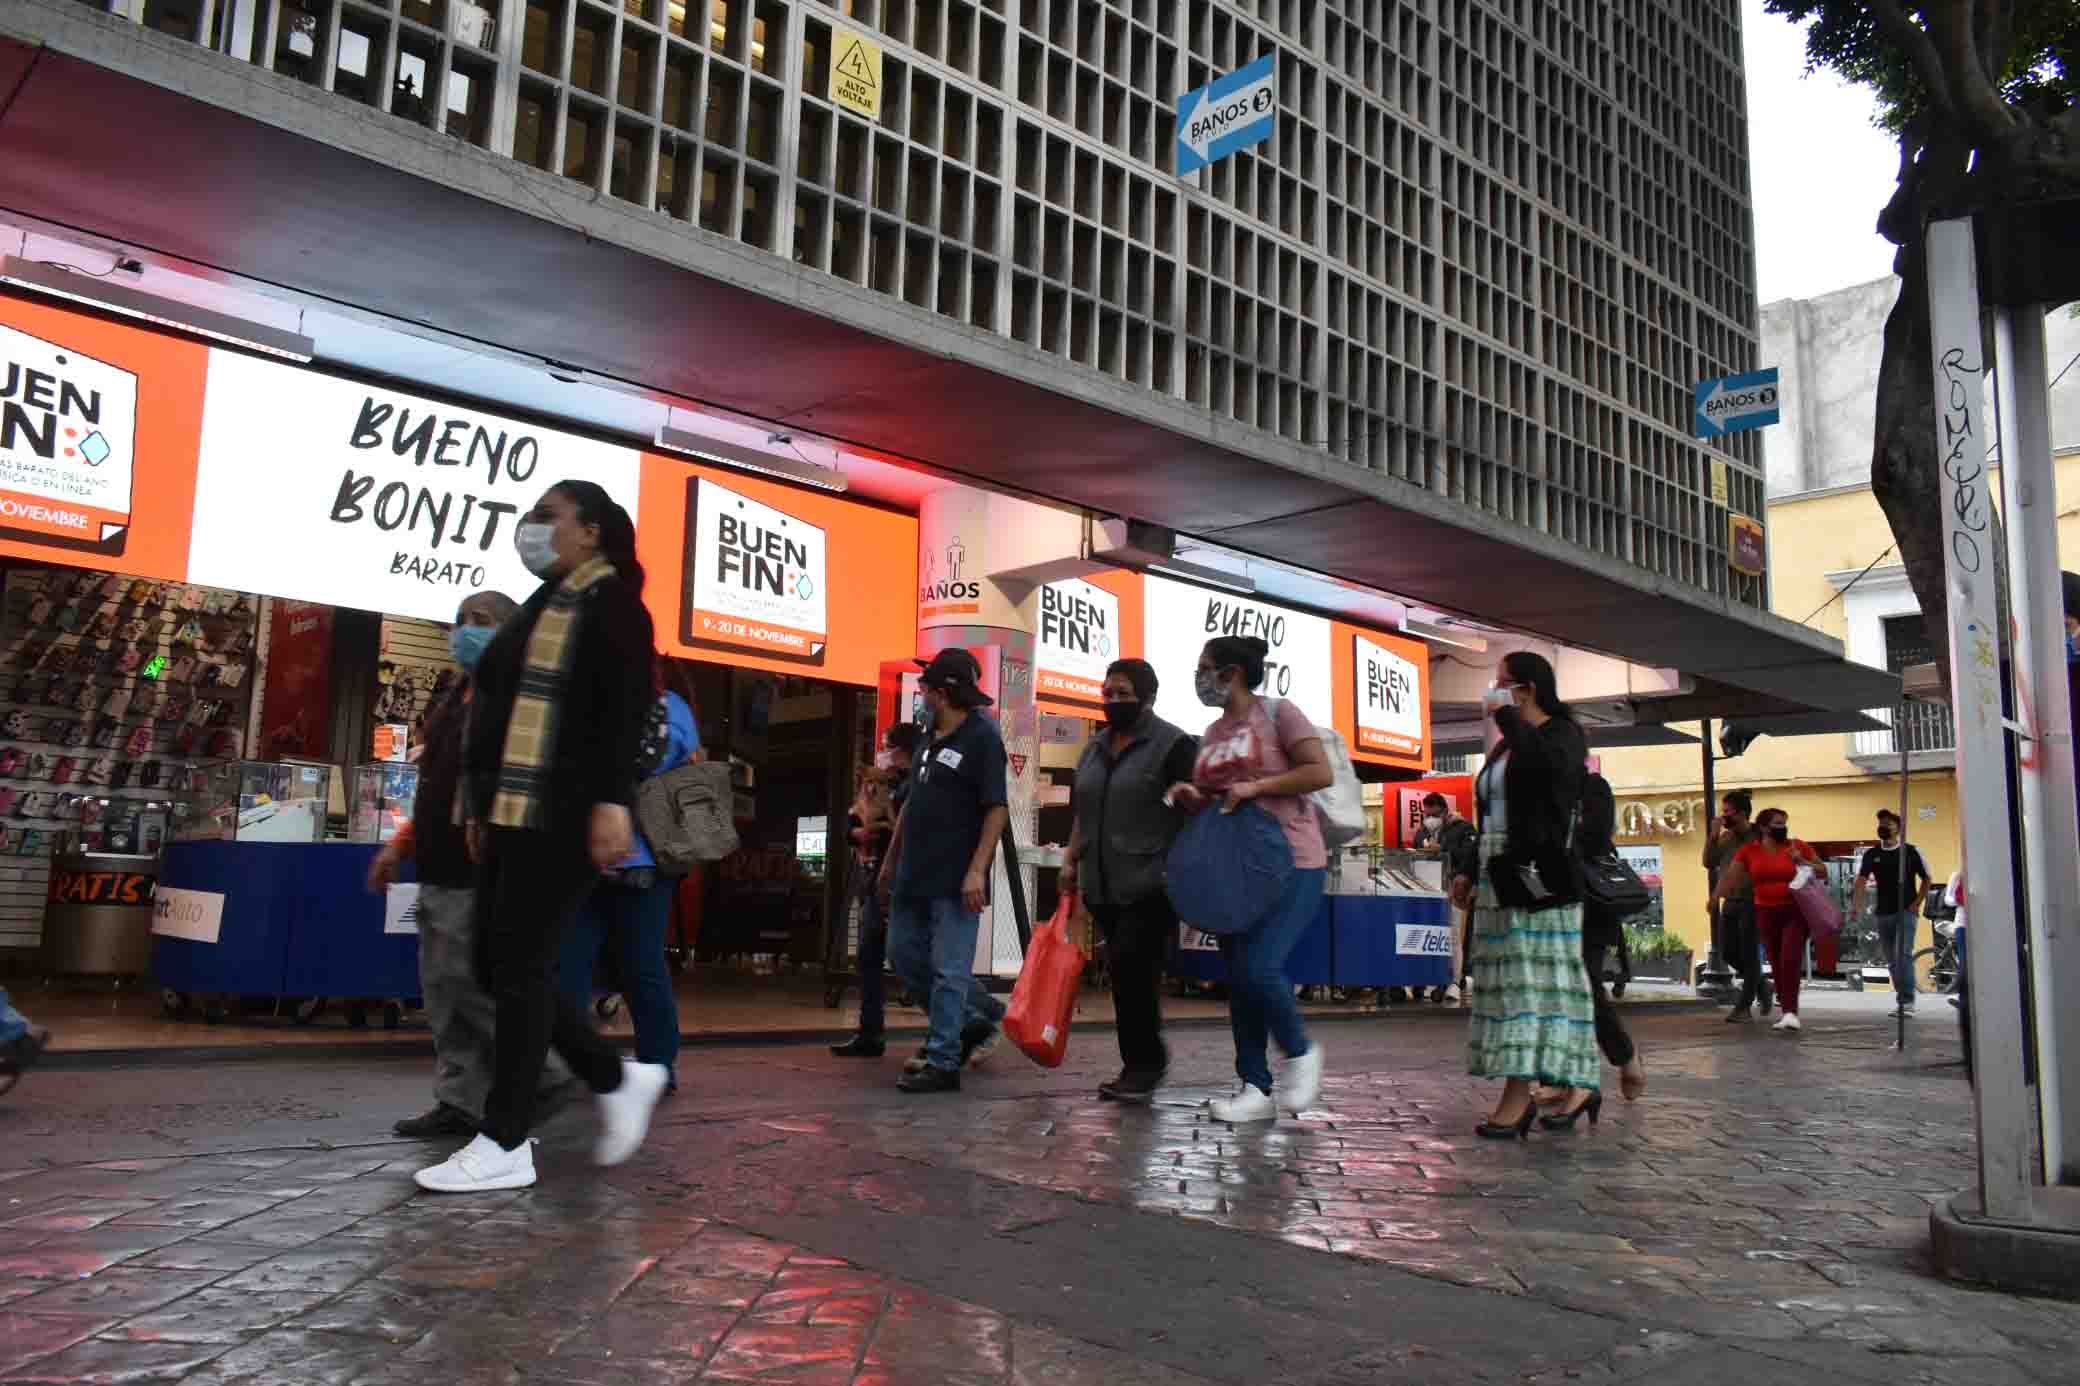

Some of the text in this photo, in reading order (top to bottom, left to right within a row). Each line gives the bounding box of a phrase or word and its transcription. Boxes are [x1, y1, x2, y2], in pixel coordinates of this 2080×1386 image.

[837, 87, 872, 109] VOLTAJE
[845, 80, 866, 95] ALTO
[350, 396, 539, 485] BUENO
[719, 512, 807, 569] BUEN
[390, 551, 485, 587] BARATO
[717, 543, 784, 597] FIN
[1041, 584, 1105, 631] BUEN
[1204, 597, 1285, 647] BUENO
[1041, 611, 1089, 655] FIN
[1368, 658, 1410, 695] BUEN
[1368, 680, 1400, 714] FIN
